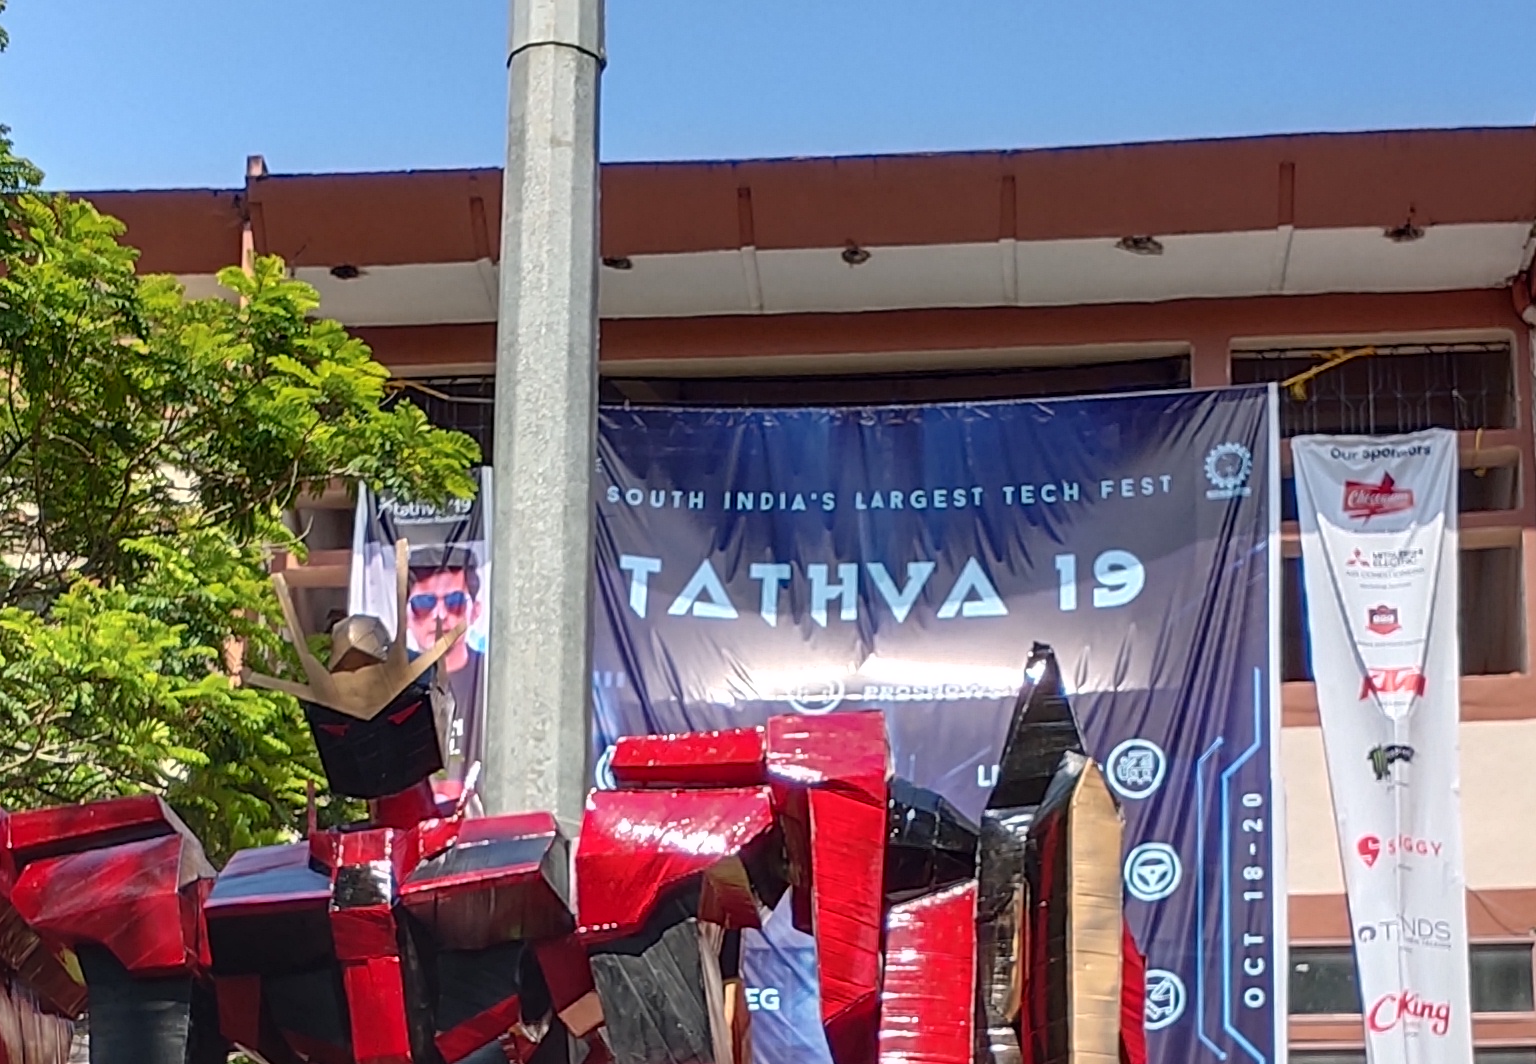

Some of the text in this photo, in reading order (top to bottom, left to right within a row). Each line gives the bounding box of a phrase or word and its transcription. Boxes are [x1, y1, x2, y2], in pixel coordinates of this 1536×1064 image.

[606, 474, 1172, 511] SOUTH INDIA'S LARGEST TECH FEST
[619, 549, 1146, 628] TATHVA 19
[1243, 932, 1265, 1009] OCT
